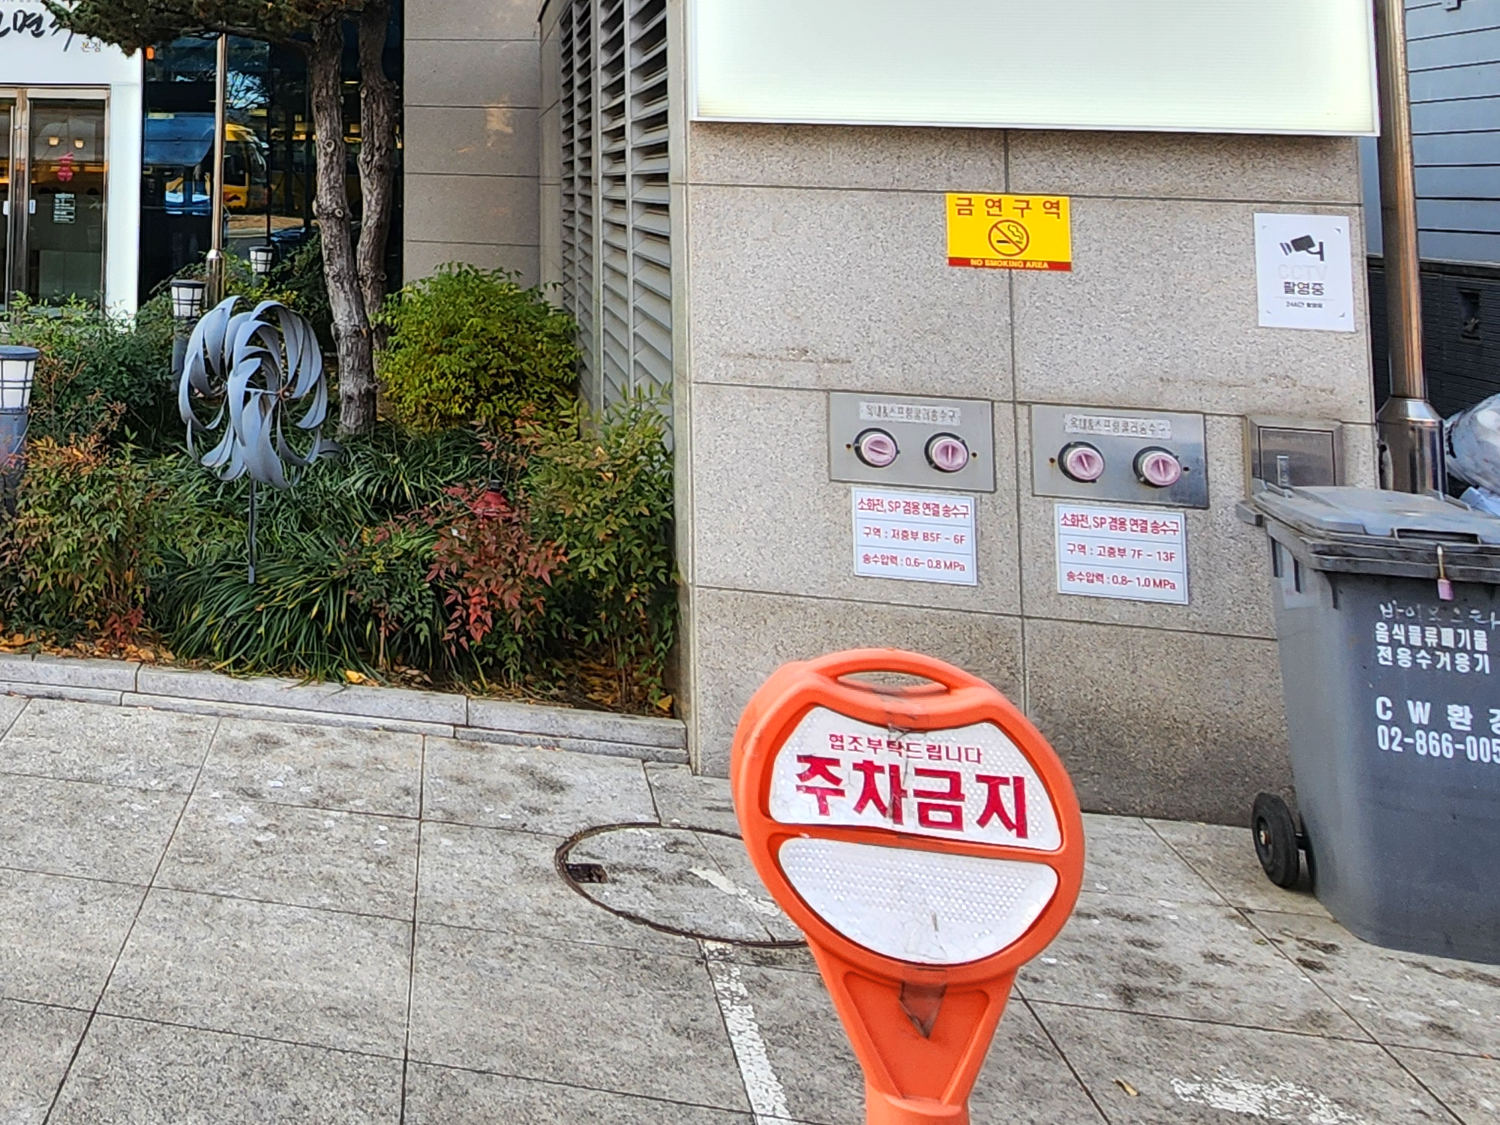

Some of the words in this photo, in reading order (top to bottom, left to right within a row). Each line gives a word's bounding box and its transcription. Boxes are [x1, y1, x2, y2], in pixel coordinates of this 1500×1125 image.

[985, 259, 1024, 268] SMOKING
[1026, 261, 1049, 269] AREA
[858, 497, 887, 514] 소화전,
[888, 500, 901, 513] SP
[922, 501, 941, 517] 연결
[942, 504, 970, 519] 송수구
[1060, 513, 1091, 530] 소화전,
[1092, 516, 1107, 529] SP
[1129, 518, 1149, 533] 연결
[1150, 520, 1180, 535] 송수구
[863, 526, 882, 539] 구역
[922, 532, 942, 543] B5F
[953, 534, 966, 544] 6F
[862, 553, 899, 567] 송수압력
[943, 560, 966, 572] MPa
[1066, 542, 1087, 556] 구역
[1130, 548, 1144, 560] 7F
[1156, 551, 1176, 563] 13F
[1066, 570, 1105, 584] 송수압력
[1152, 578, 1177, 591] MPa
[1376, 645, 1490, 674] 전용수거용기
[828, 733, 983, 765] 협조부탁드립니다
[795, 754, 1029, 839] 주차금지
